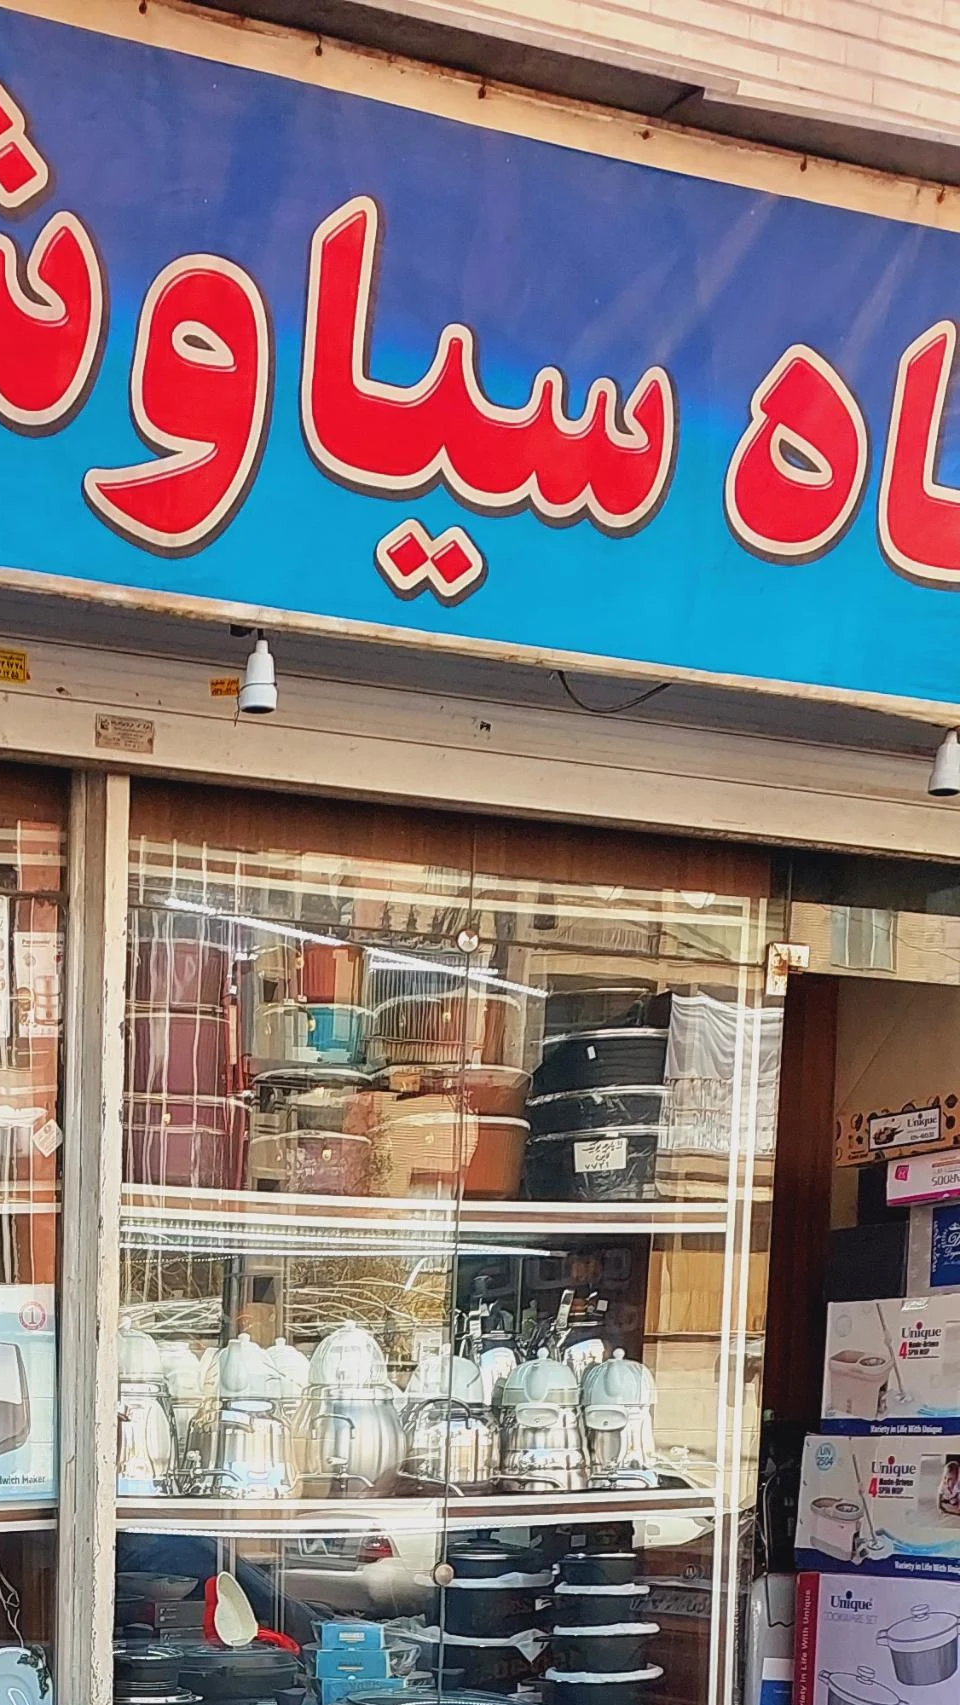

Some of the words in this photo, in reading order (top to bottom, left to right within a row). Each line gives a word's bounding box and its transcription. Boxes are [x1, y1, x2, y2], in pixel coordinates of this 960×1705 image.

[907, 1113, 937, 1128] Unique
[901, 1321, 942, 1340] Unique
[898, 1341, 907, 1359] 4
[872, 1456, 917, 1477] Unique
[868, 1477, 878, 1498] 4
[830, 1590, 873, 1612] Unique
